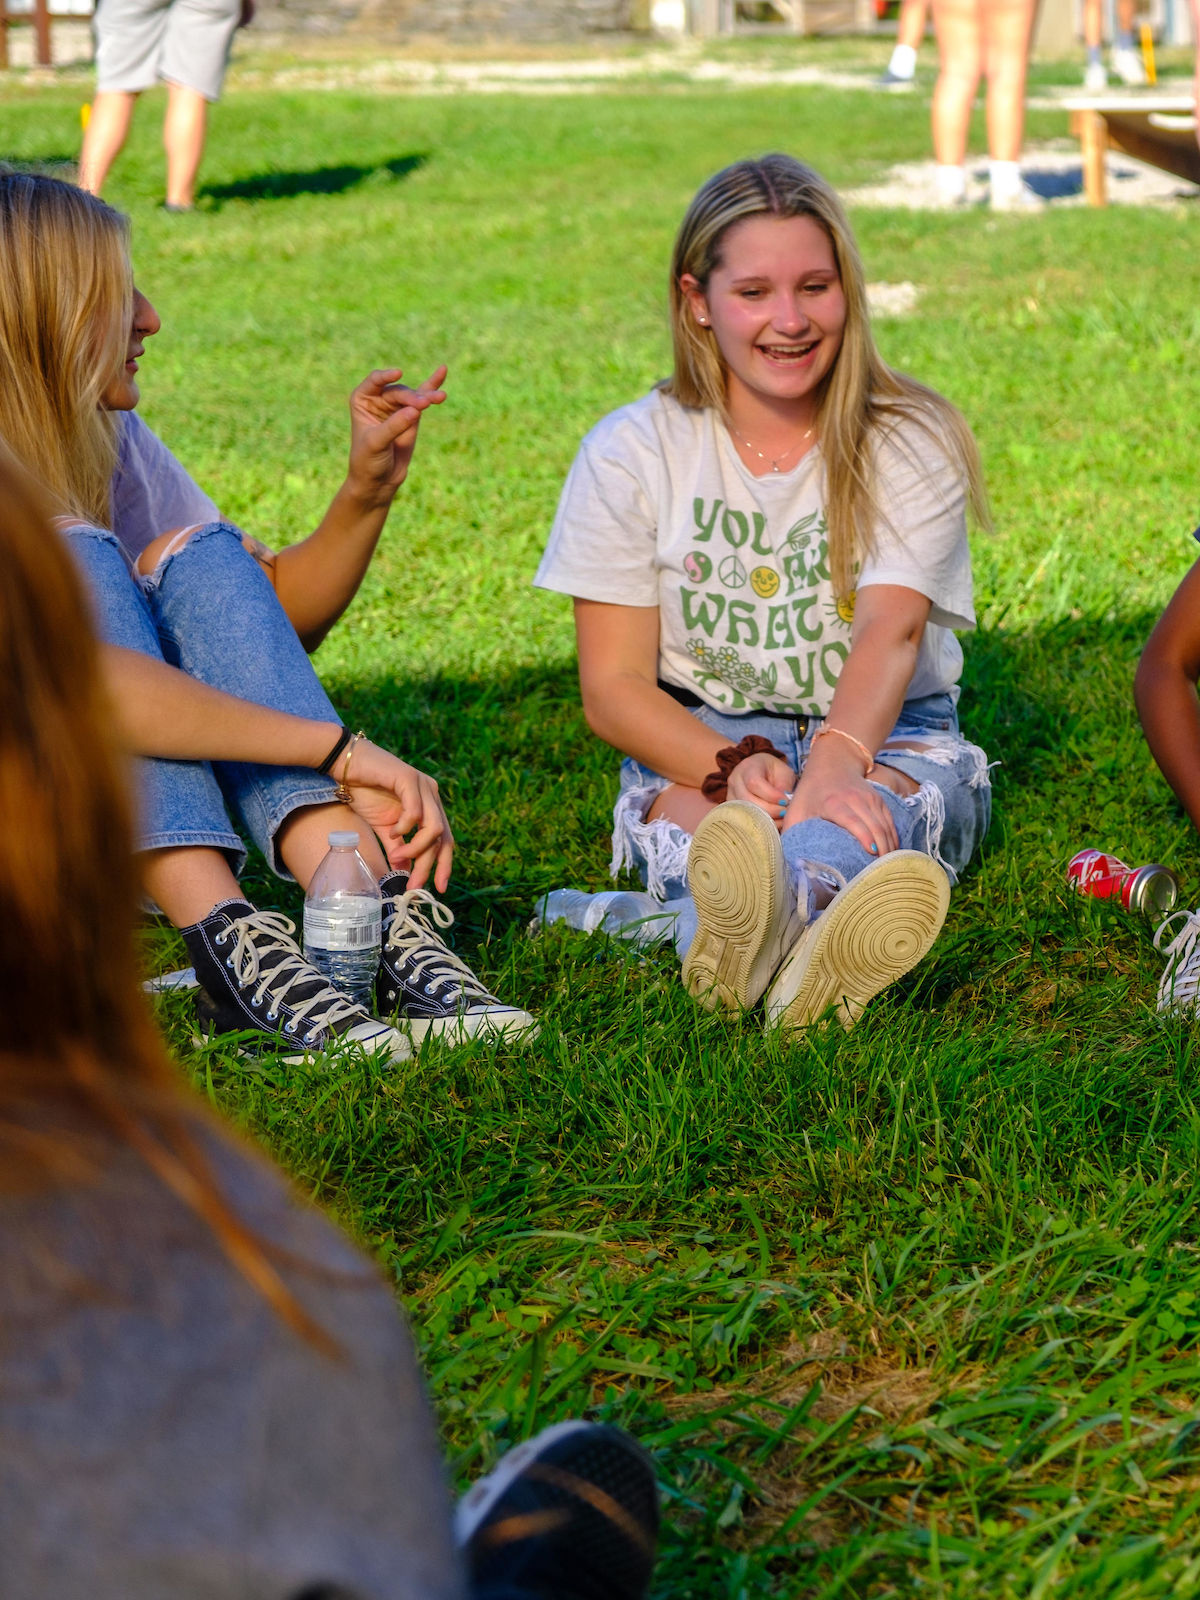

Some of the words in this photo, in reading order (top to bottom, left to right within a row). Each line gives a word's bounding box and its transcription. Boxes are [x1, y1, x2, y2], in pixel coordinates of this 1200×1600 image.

[782, 539, 831, 597] AR
[679, 585, 823, 650] WHAT
[784, 640, 852, 699] YO
